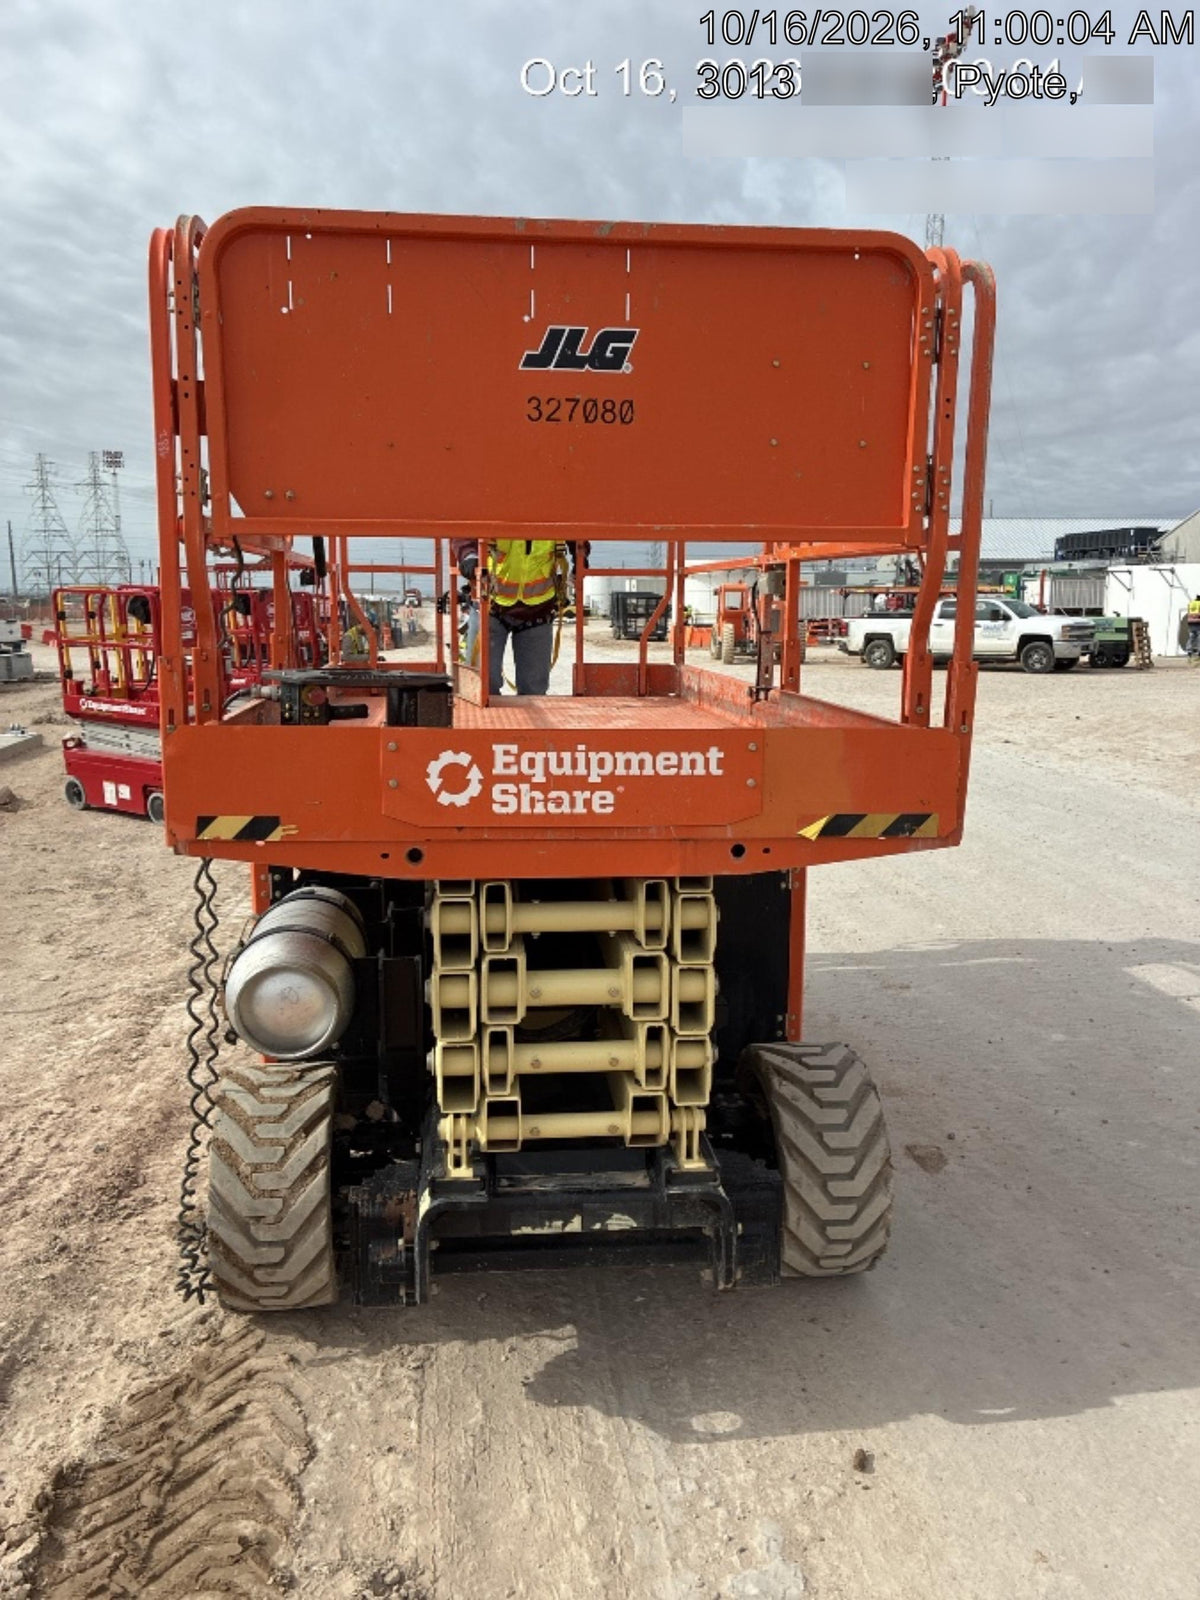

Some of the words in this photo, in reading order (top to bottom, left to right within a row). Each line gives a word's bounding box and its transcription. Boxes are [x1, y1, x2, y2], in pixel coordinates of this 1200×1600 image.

[519, 324, 640, 374] JLG
[527, 396, 634, 425] 327080
[491, 743, 725, 783] Equipment
[491, 783, 615, 814] Share
